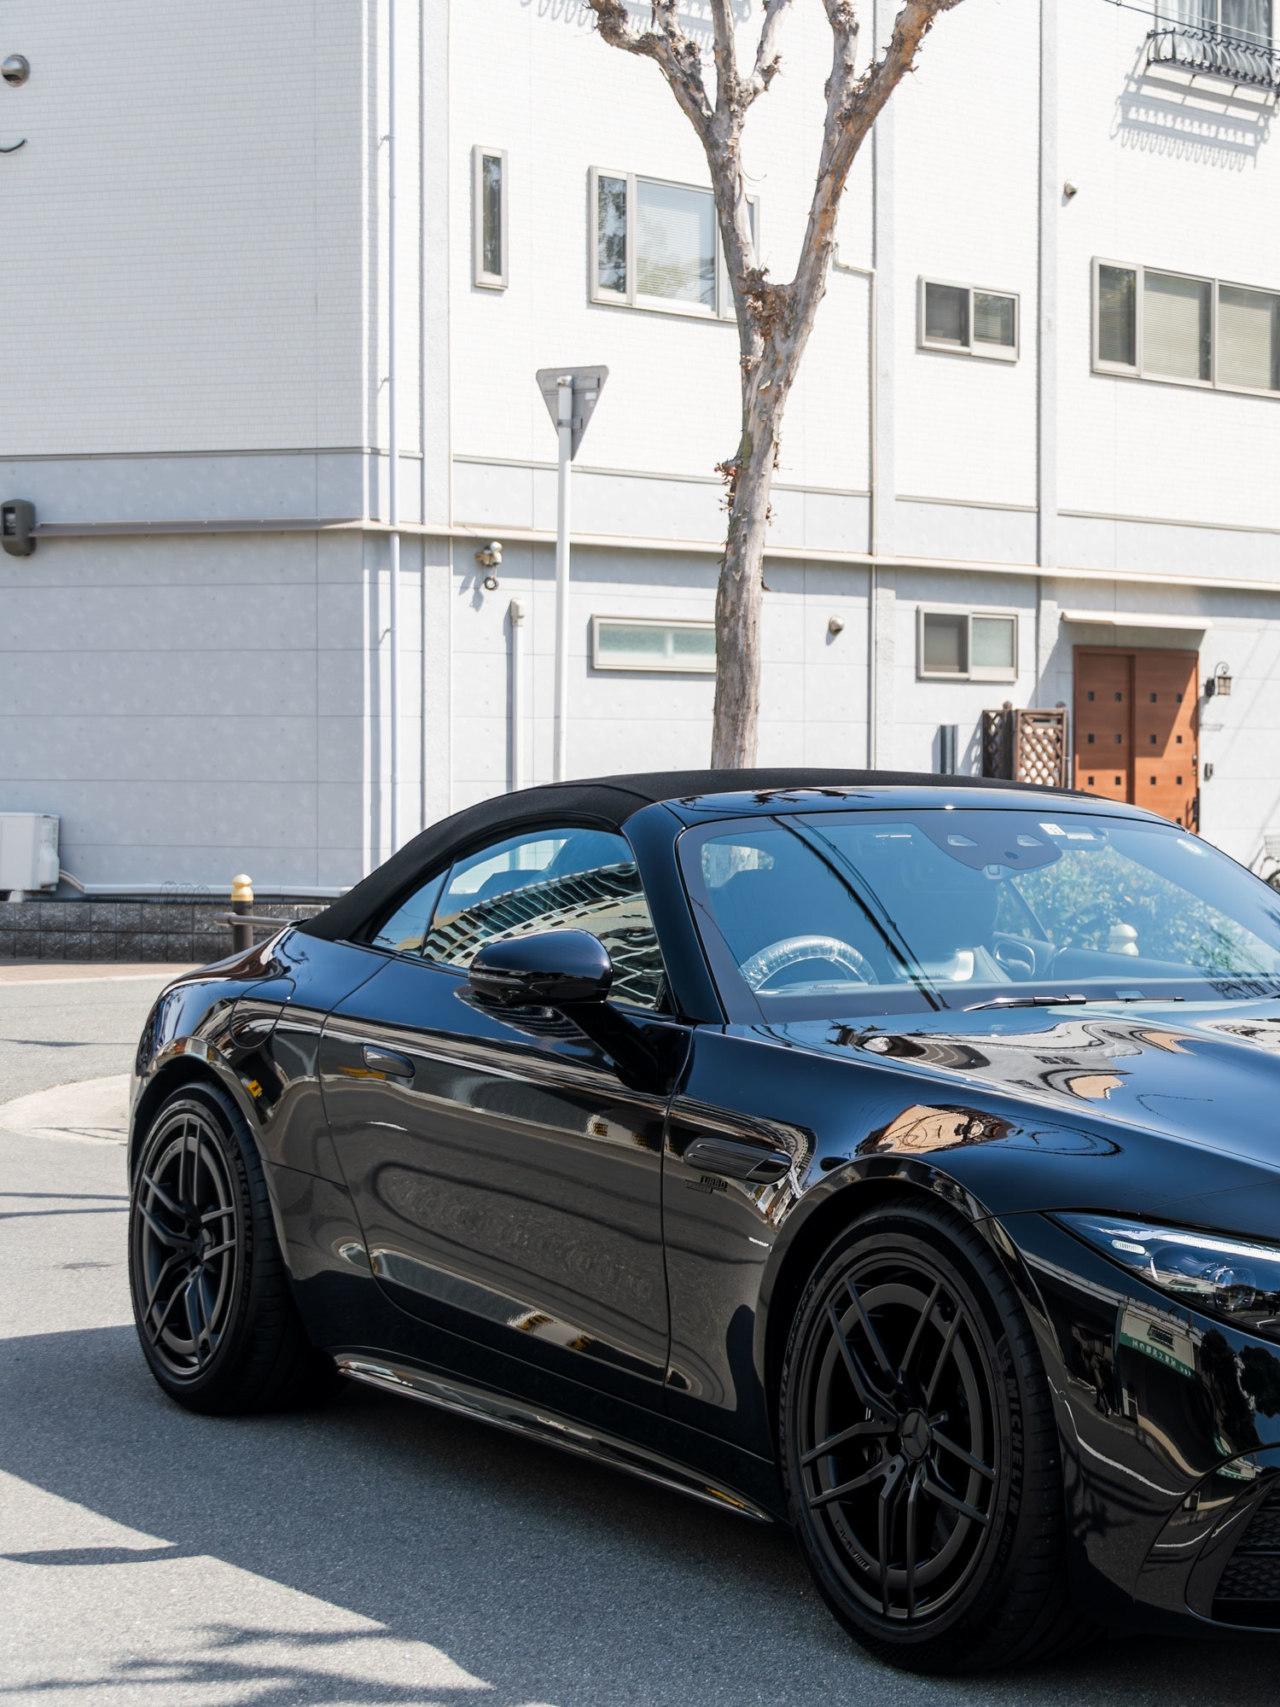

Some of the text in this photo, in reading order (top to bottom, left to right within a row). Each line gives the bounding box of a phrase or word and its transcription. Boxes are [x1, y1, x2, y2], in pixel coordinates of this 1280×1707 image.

[235, 1158, 253, 1254] MICHELIN
[1004, 1378, 1024, 1517] MICHELIN
[998, 1524, 1013, 1562] PILOT
